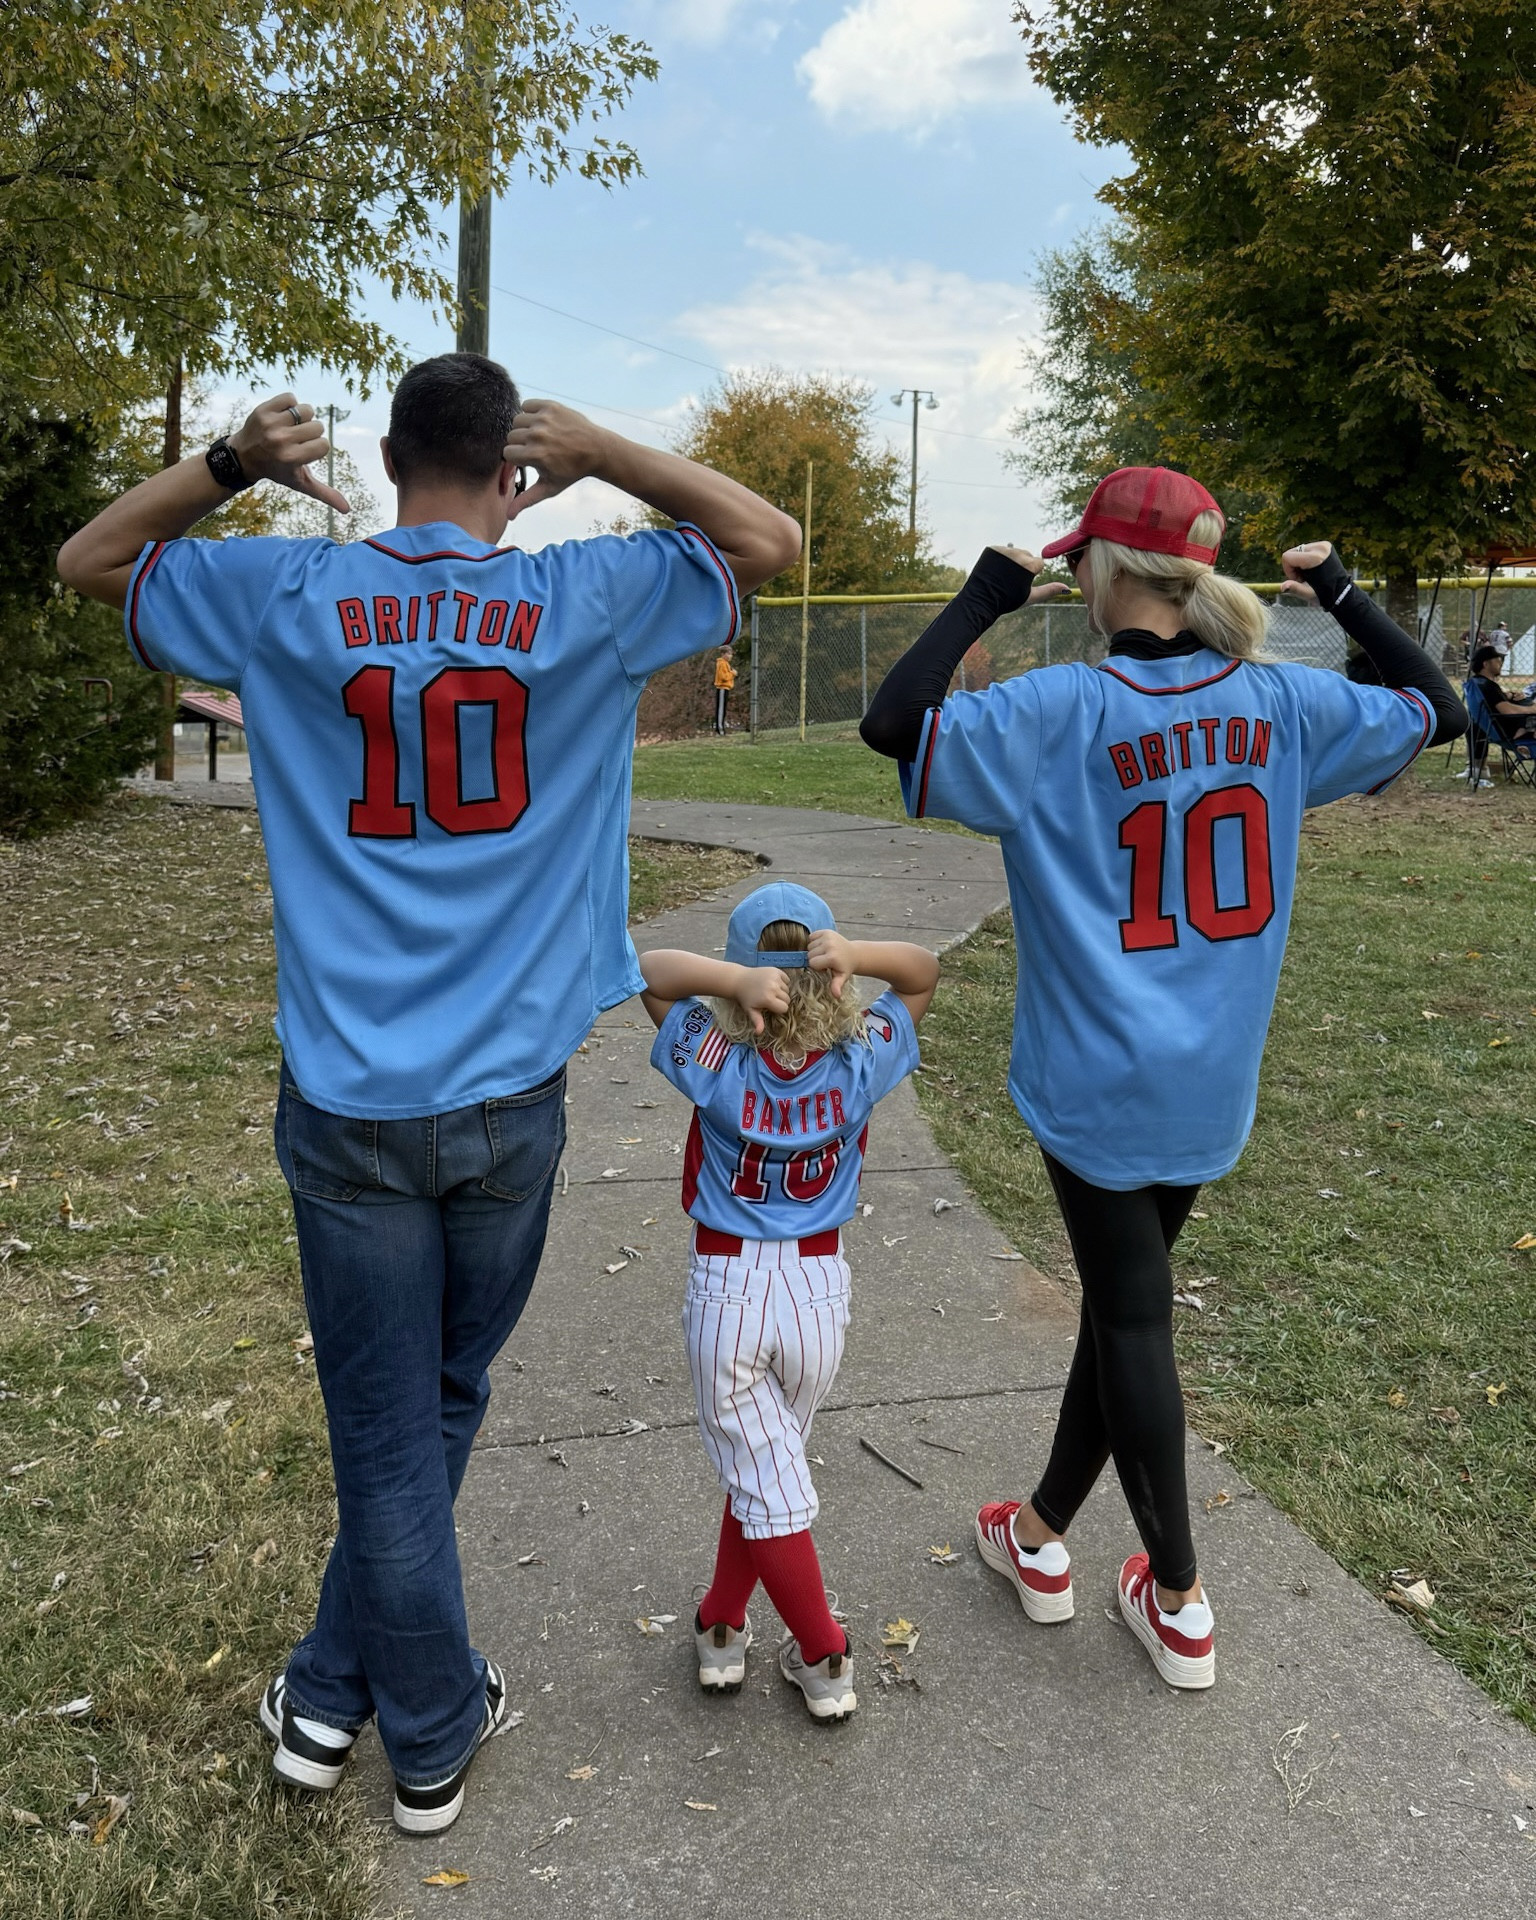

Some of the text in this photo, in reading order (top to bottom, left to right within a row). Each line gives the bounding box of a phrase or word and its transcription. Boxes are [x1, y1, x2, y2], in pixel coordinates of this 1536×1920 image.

[336, 589, 544, 654] BRITTON
[341, 663, 531, 839] 10
[1118, 782, 1275, 953] 10
[740, 1086, 847, 1137] BAXTER
[730, 1135, 845, 1205] 10
